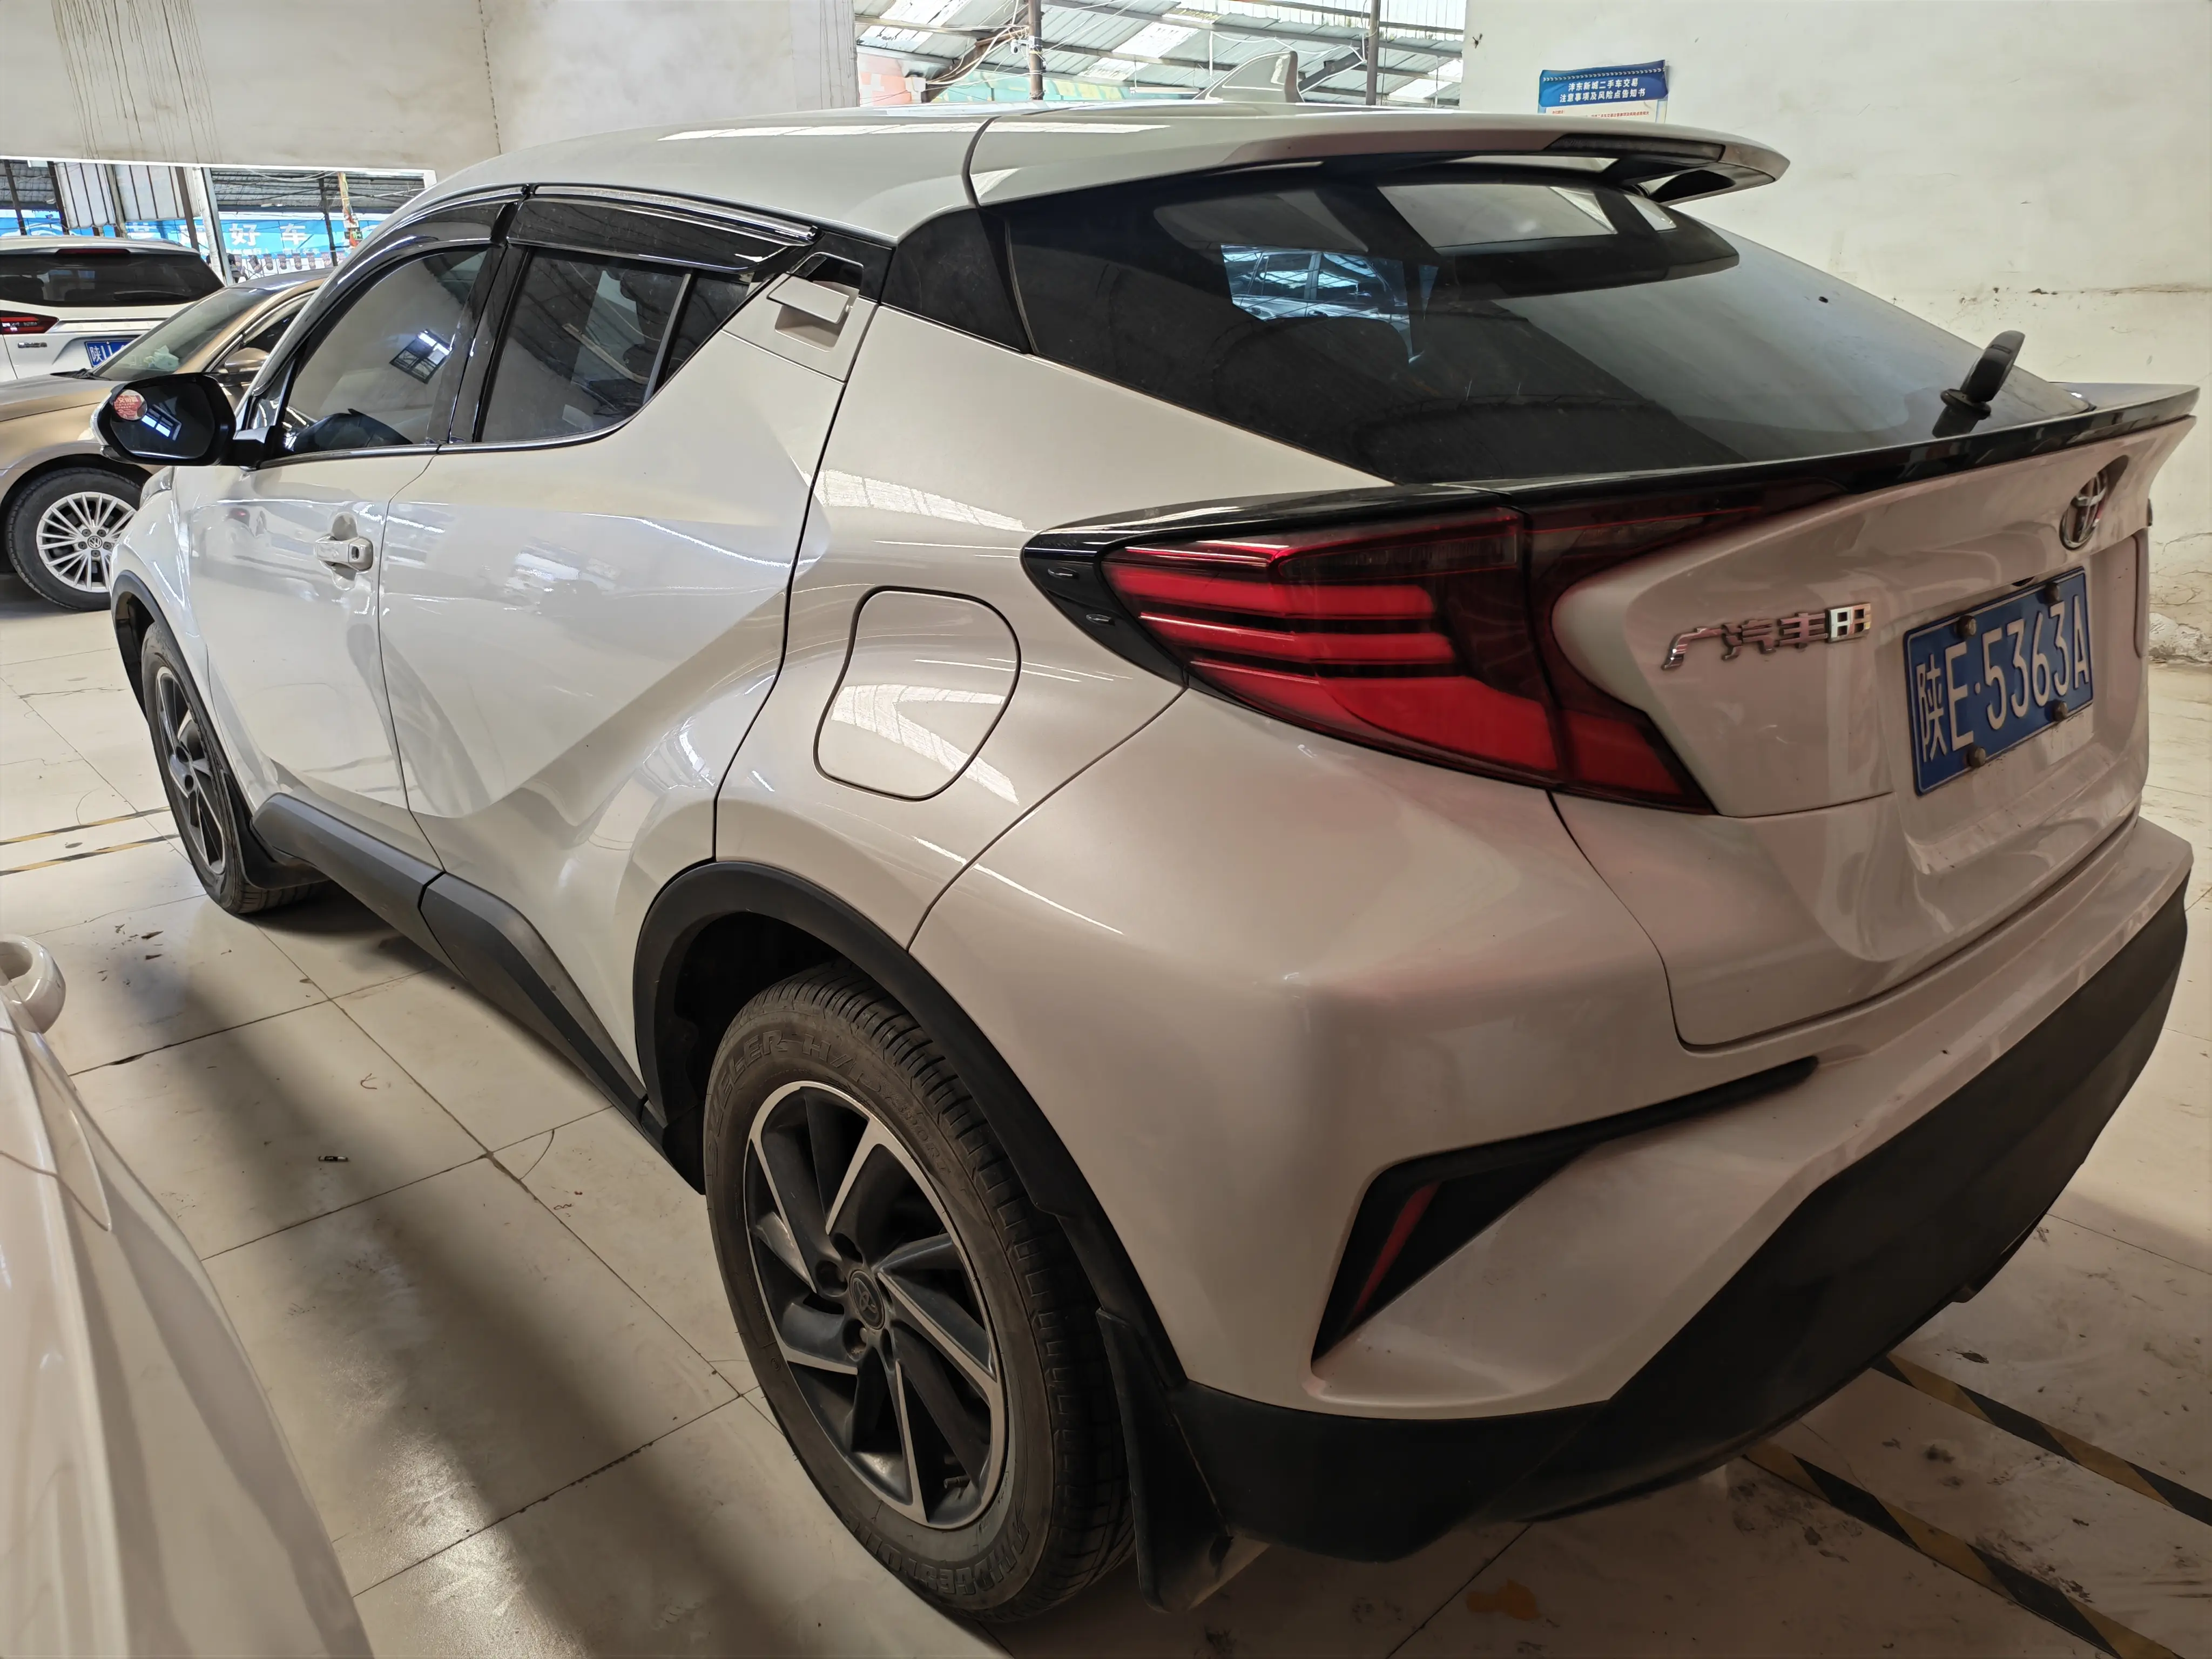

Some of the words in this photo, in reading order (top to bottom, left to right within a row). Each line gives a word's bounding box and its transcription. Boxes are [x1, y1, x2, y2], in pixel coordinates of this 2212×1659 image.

[1560, 88, 1646, 103] 注意事项及风险点告知书
[1661, 602, 1871, 671] 广汽丰田
